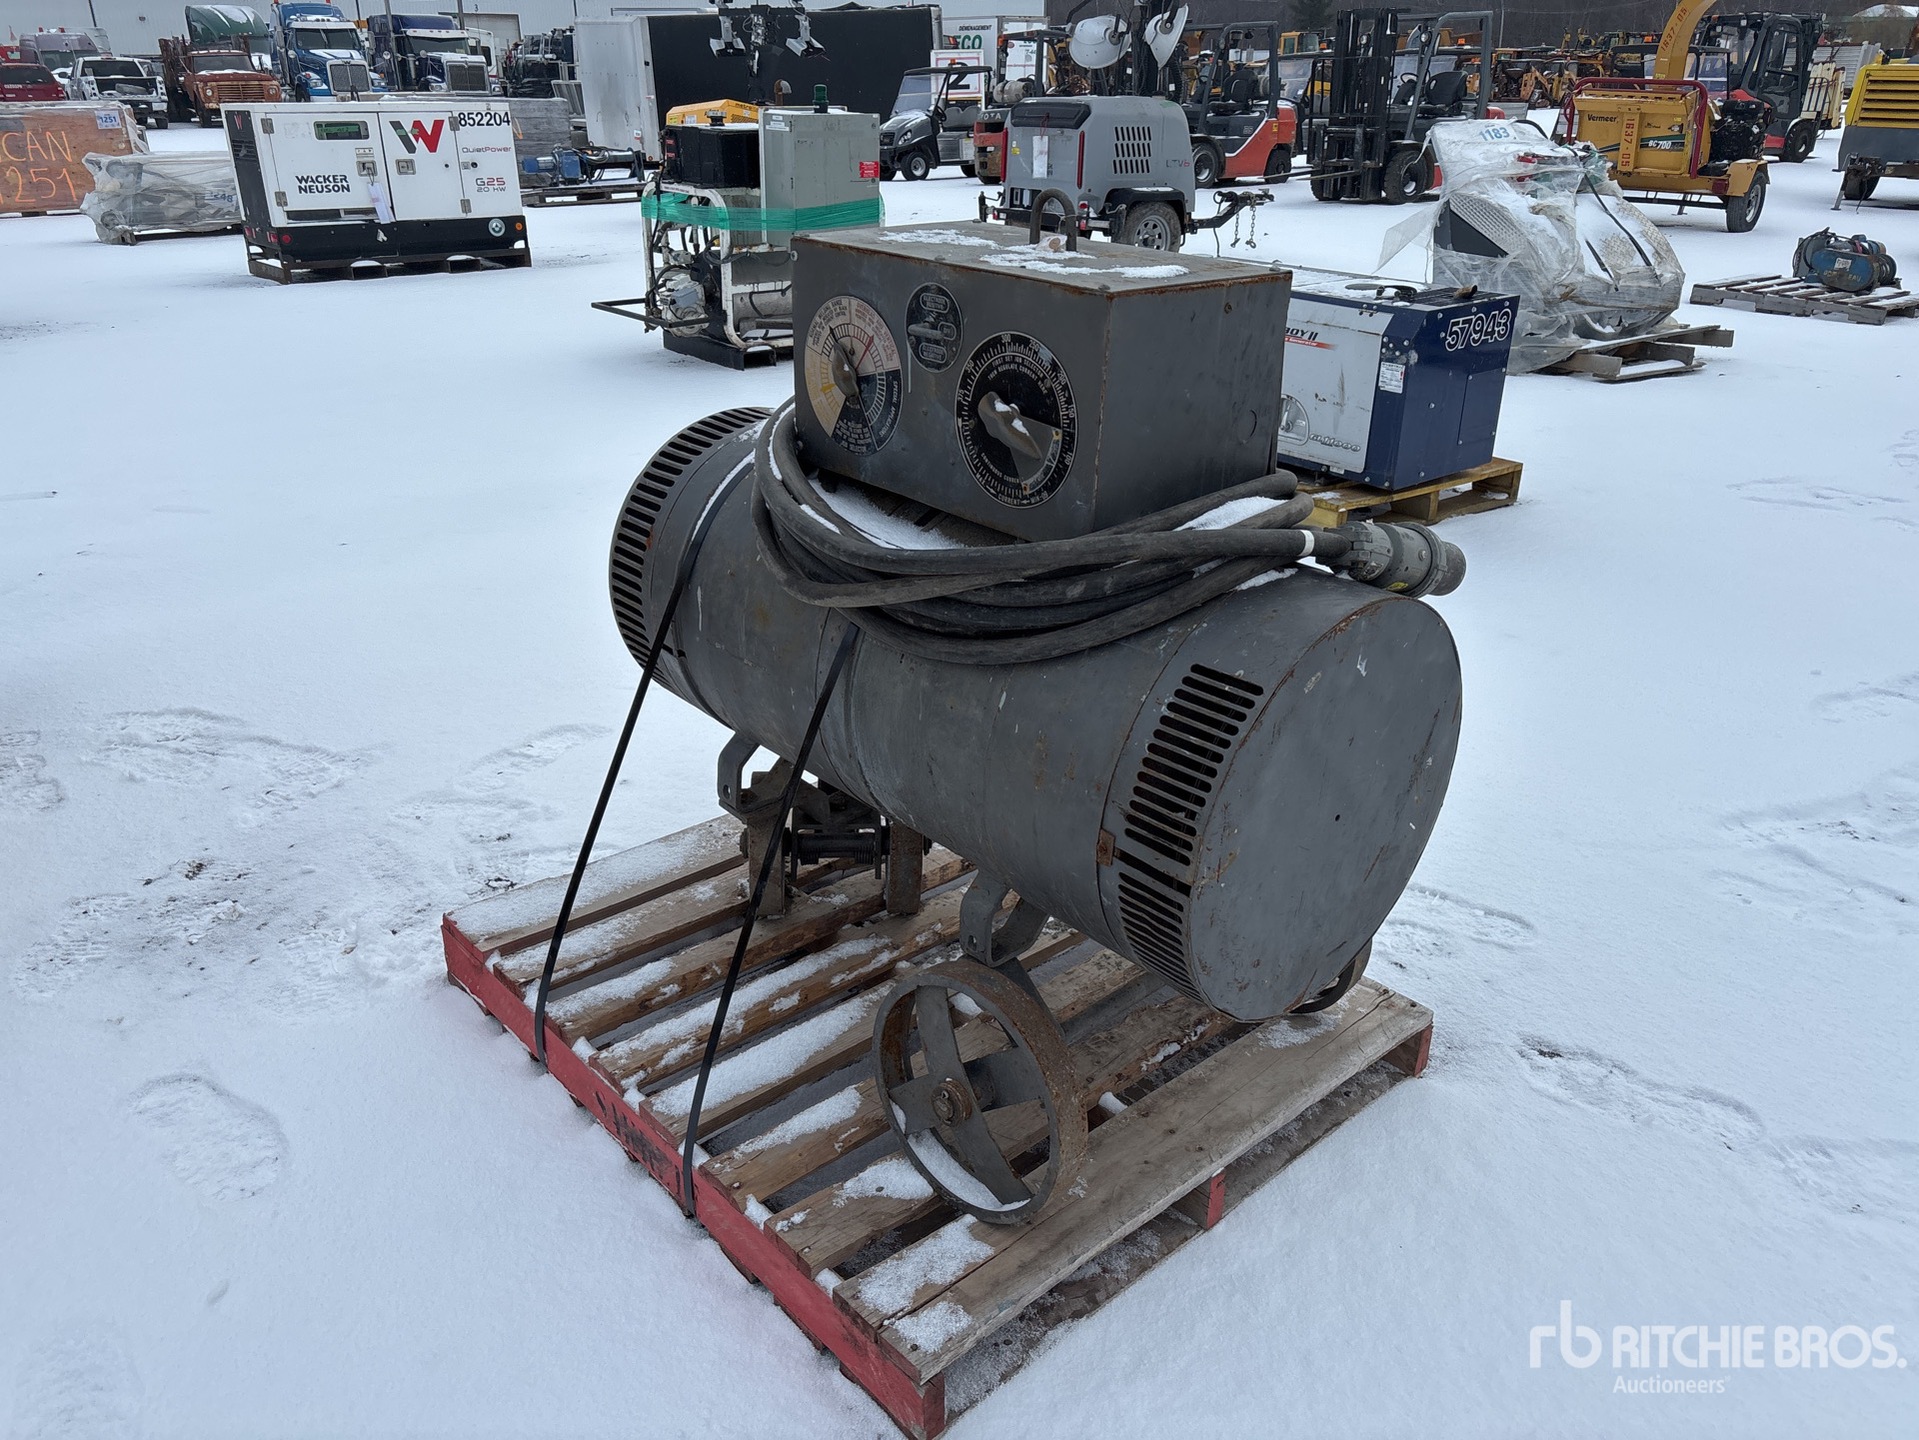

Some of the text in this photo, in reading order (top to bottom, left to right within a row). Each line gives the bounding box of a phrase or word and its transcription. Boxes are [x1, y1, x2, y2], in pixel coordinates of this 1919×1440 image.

[99, 116, 117, 124] 1251
[458, 111, 511, 128] 852204
[1587, 114, 1617, 123] Vermeer
[1479, 127, 1510, 141] 1183
[2, 131, 73, 162] CAN
[461, 145, 512, 154] QuietPower
[295, 174, 349, 185] WACKER
[475, 177, 506, 187] G25
[297, 183, 351, 195] NEUSON
[1445, 308, 1512, 352] 57943
[1028, 339, 1040, 352] 250
[1064, 451, 1074, 466] 100
